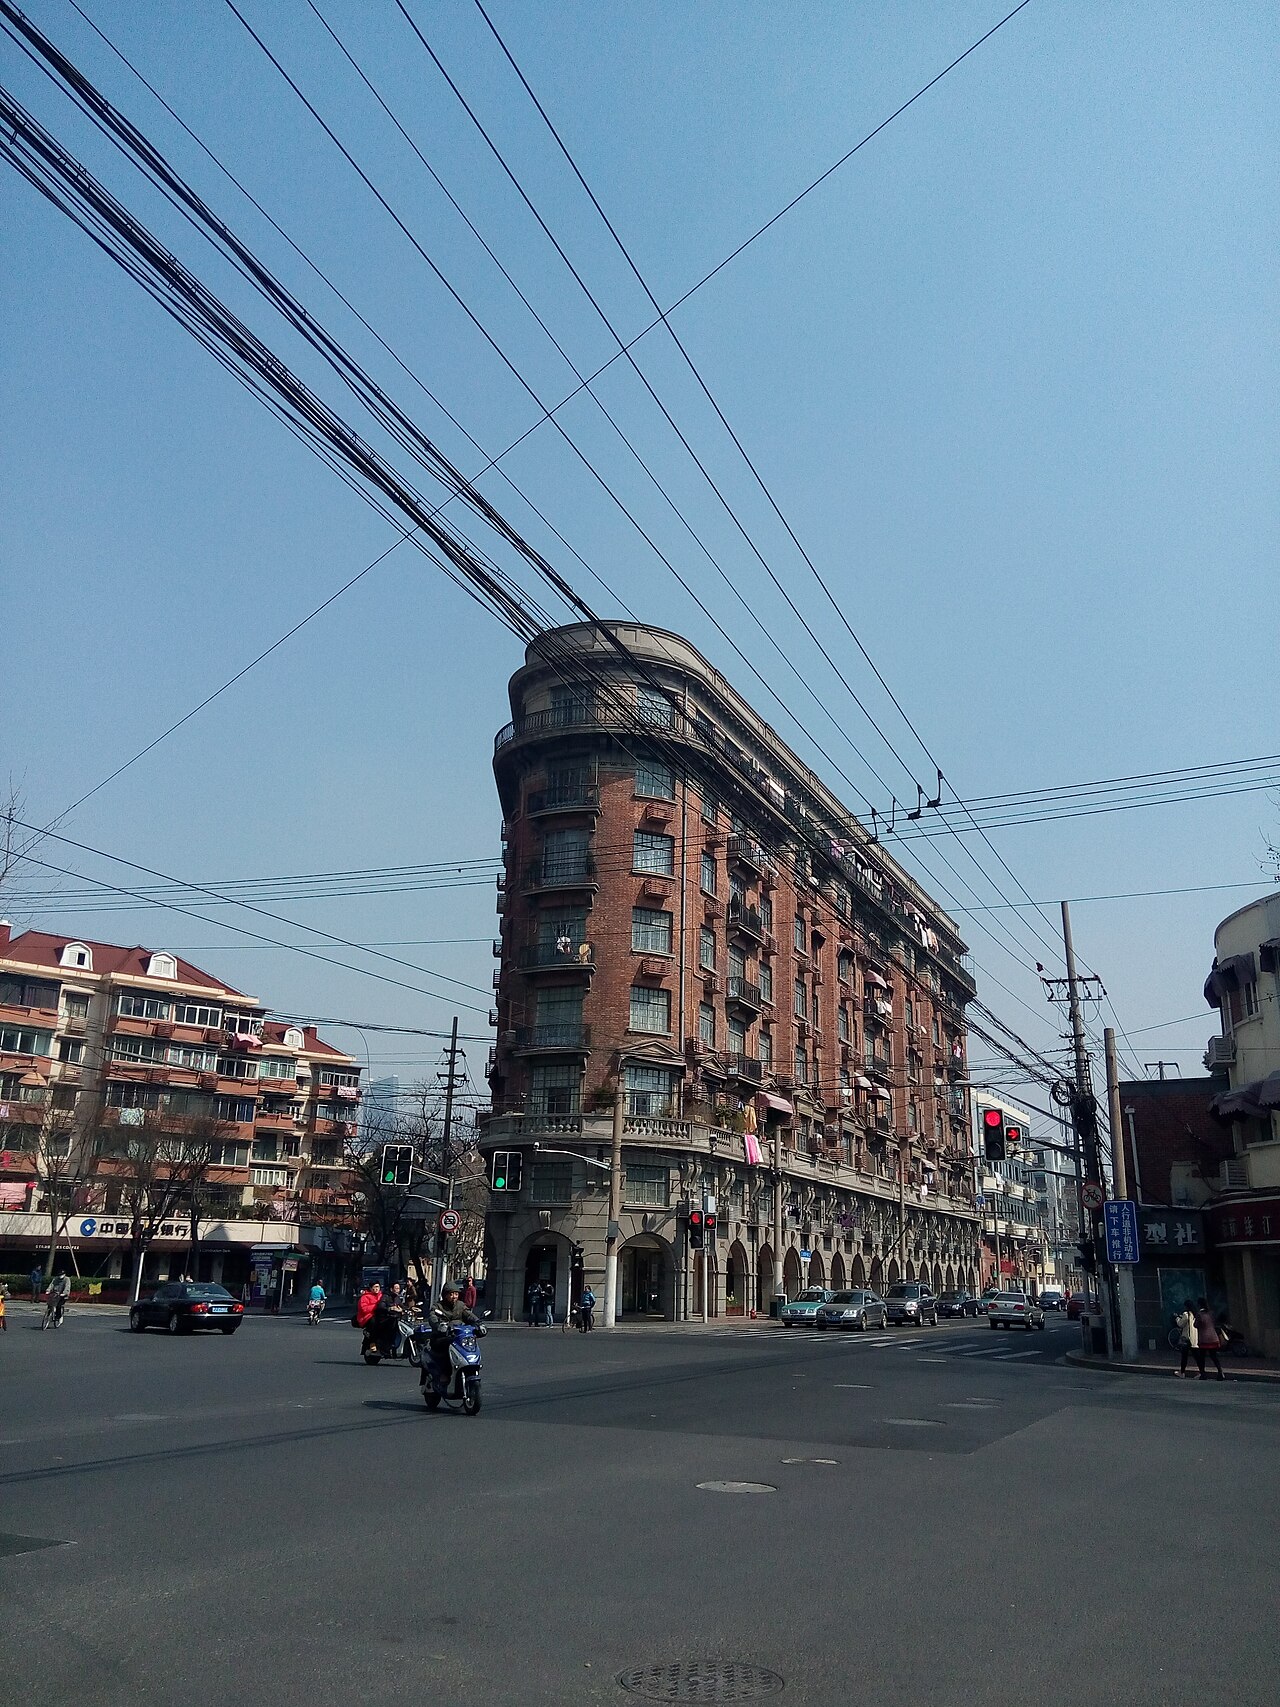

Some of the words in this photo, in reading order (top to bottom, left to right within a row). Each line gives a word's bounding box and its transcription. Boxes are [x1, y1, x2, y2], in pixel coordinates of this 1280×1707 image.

[1109, 1204, 1122, 1260] 请下车推行
[1121, 1203, 1134, 1261] 人行道非机动车
